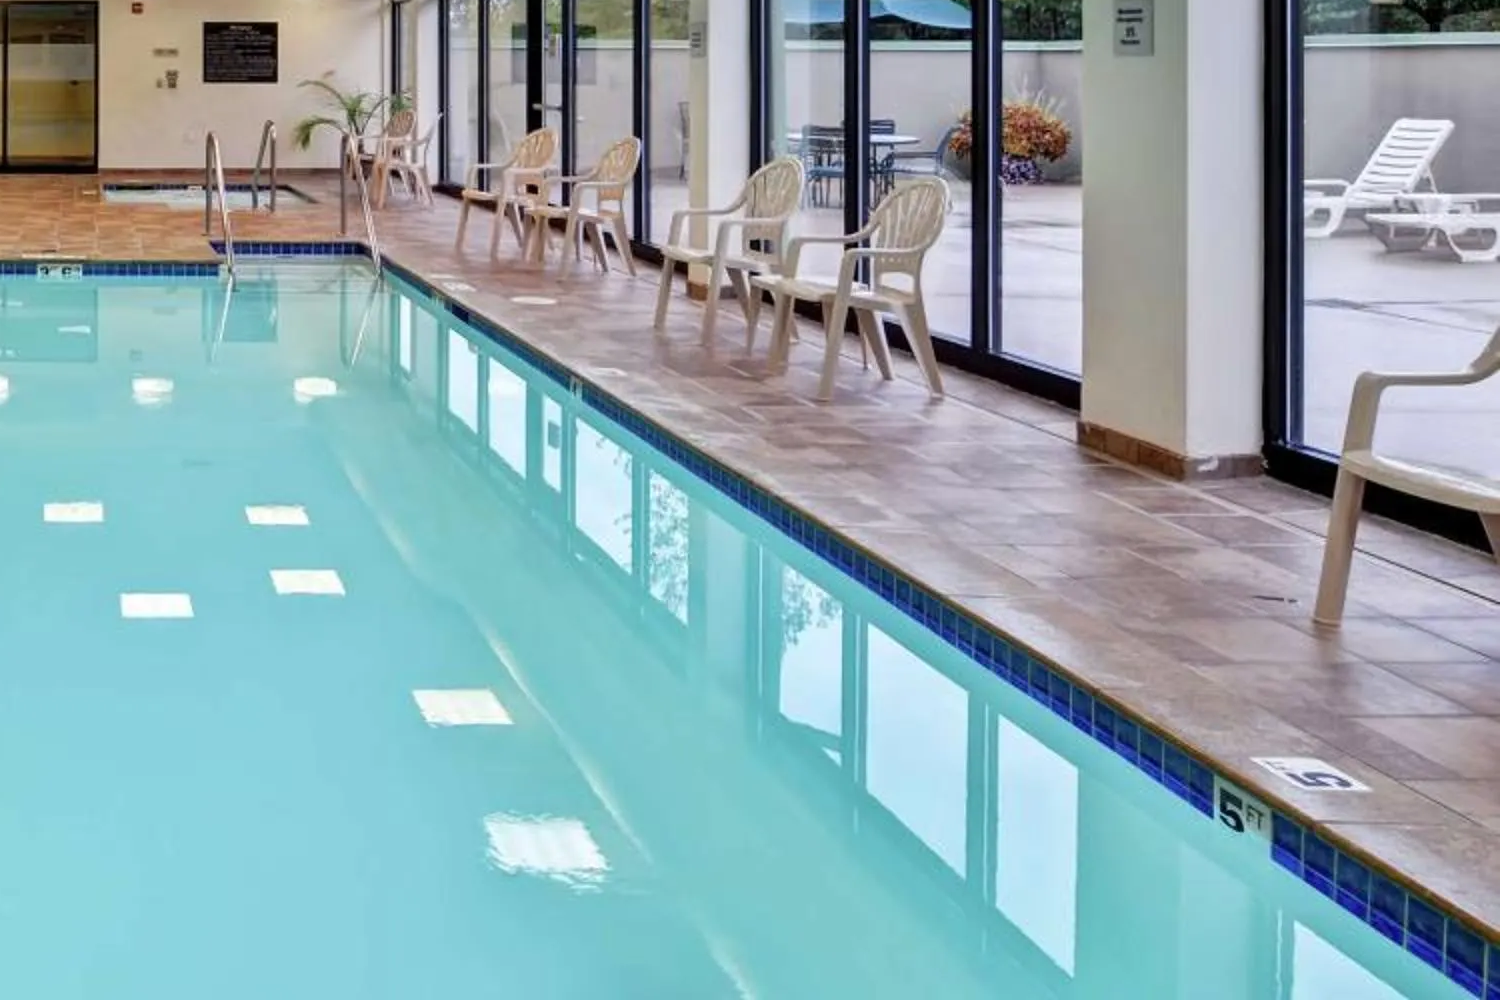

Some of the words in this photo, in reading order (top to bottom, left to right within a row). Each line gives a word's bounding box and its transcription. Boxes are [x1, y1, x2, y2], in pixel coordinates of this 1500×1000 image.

[1285, 771, 1353, 788] 5
[1219, 787, 1245, 833] 5
[1245, 804, 1265, 830] FT
